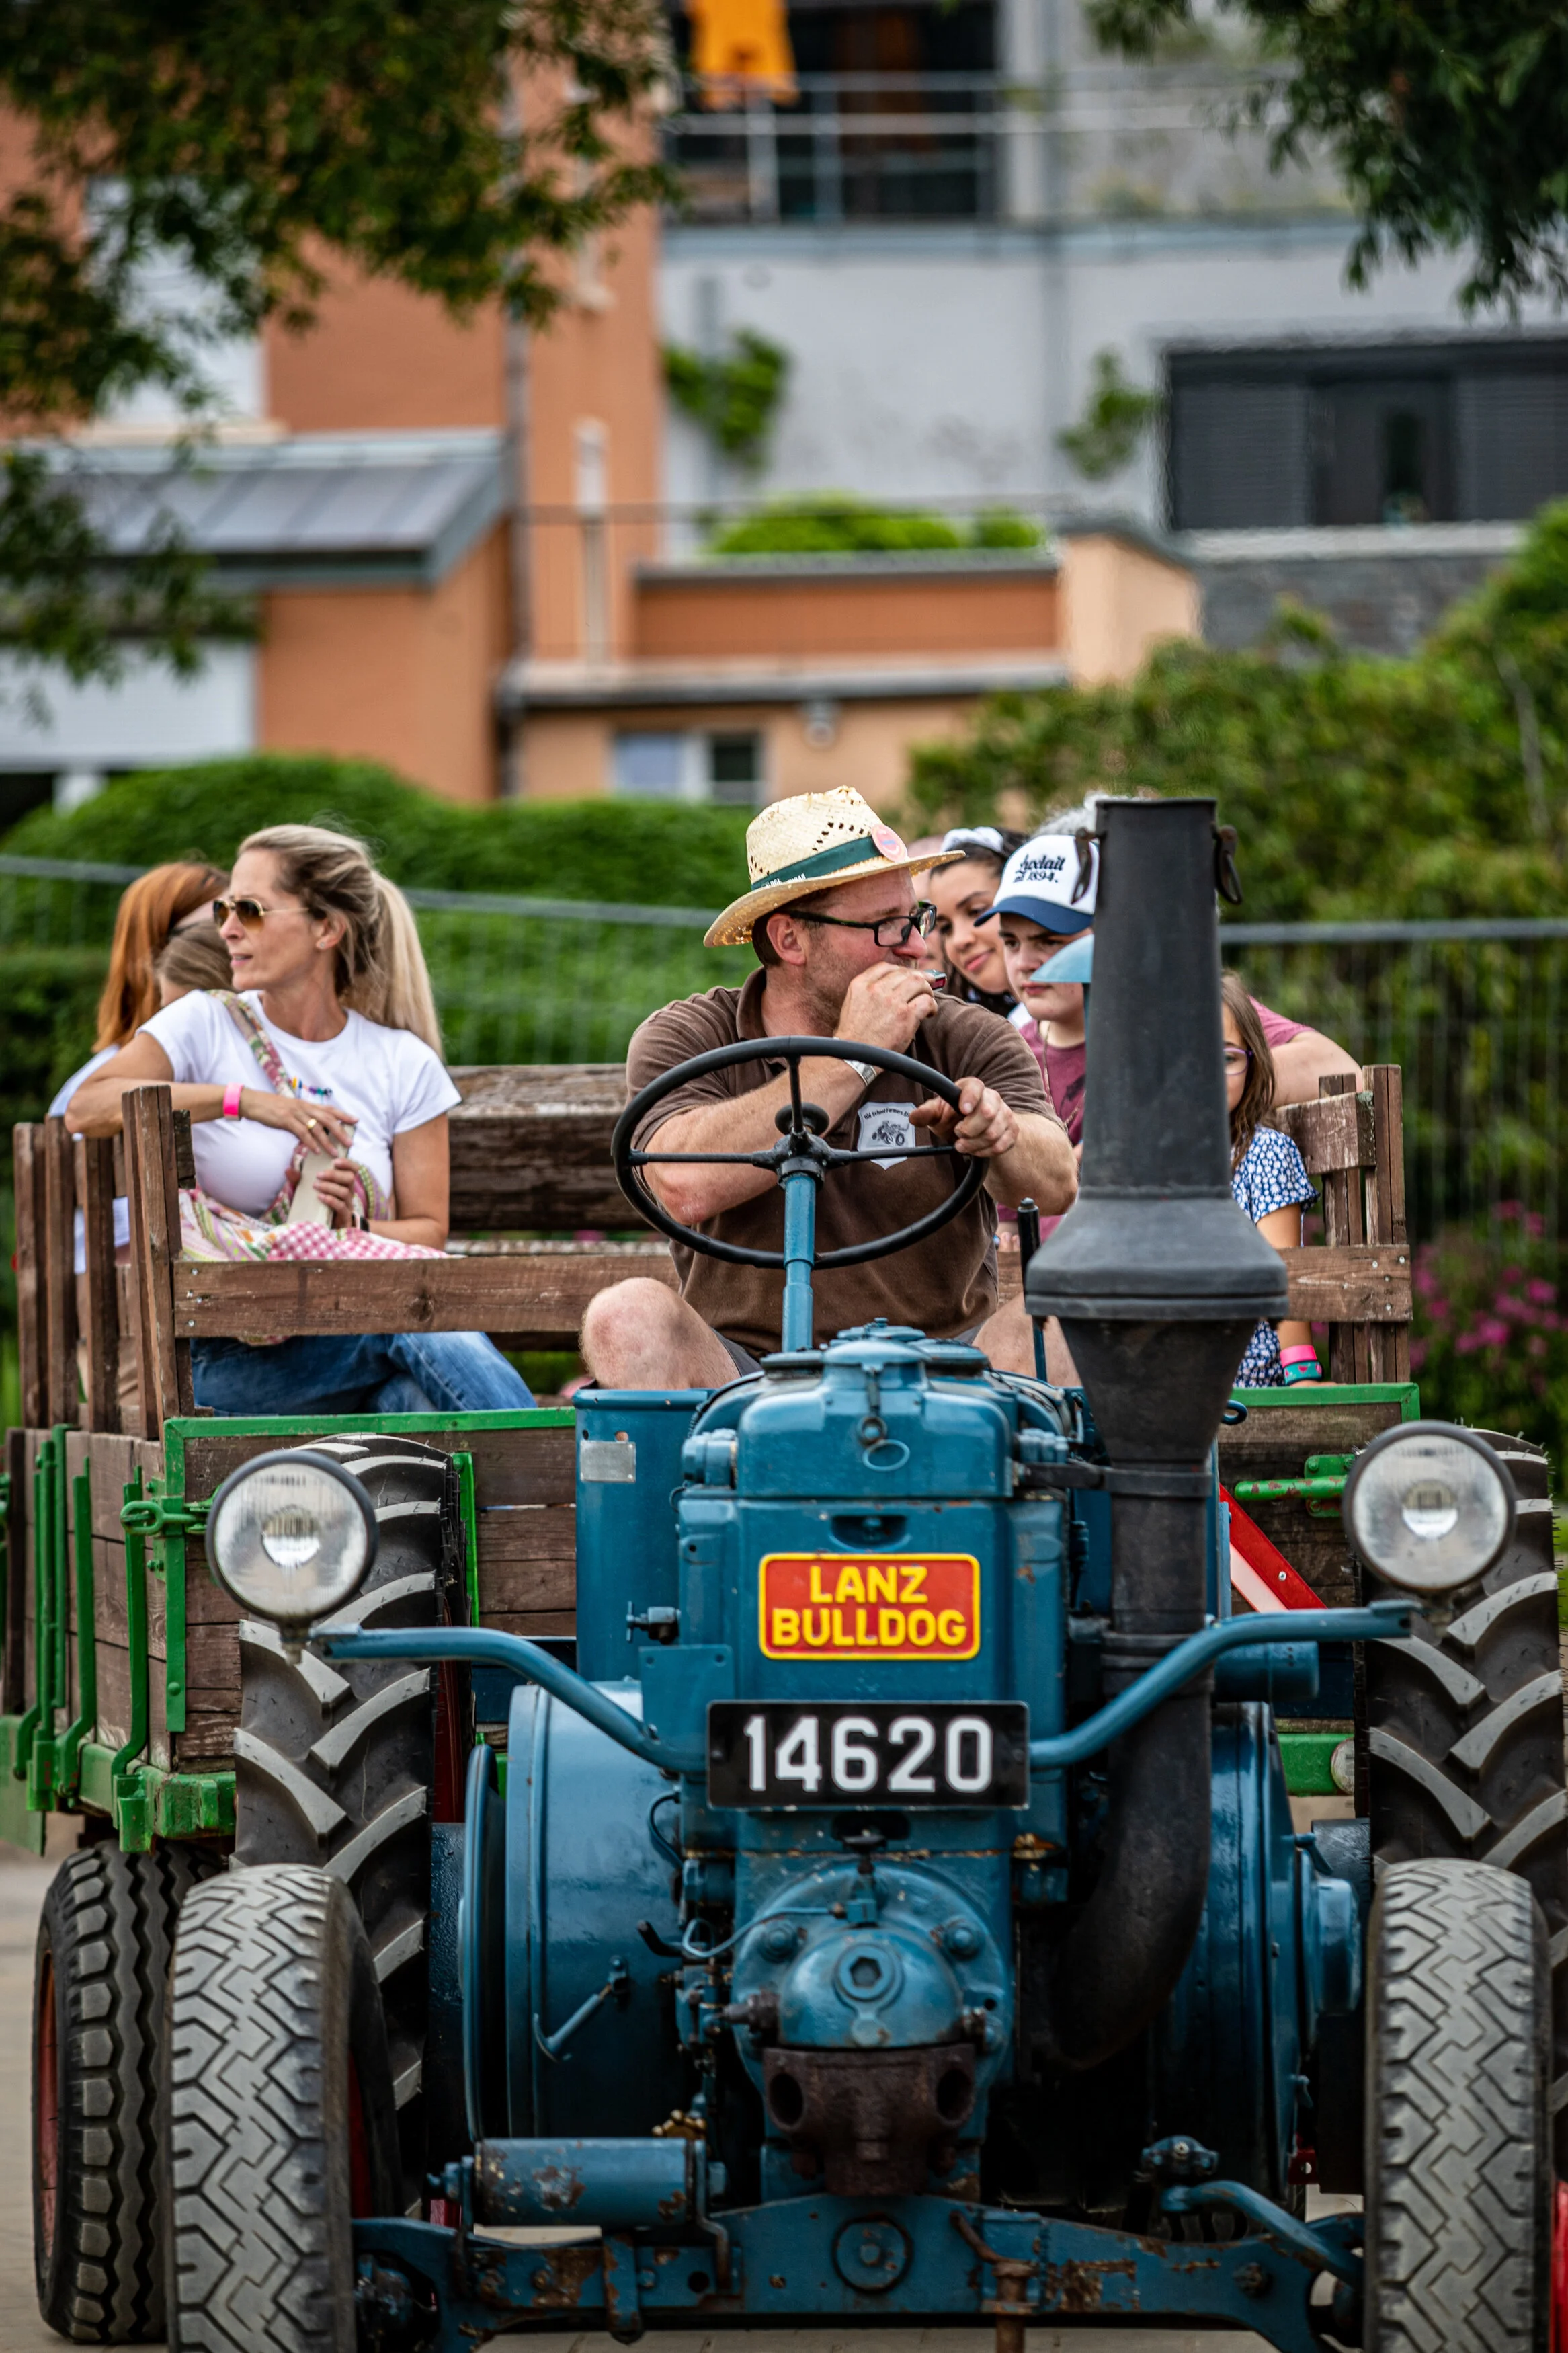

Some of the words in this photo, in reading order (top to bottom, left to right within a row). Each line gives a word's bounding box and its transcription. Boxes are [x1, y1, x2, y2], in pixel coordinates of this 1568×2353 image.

[864, 1111, 872, 1120] Old
[871, 1108, 886, 1117] School
[809, 1565, 928, 1605] LANZ
[772, 1607, 967, 1647] BULLDOG
[743, 1714, 993, 1794] 14620
